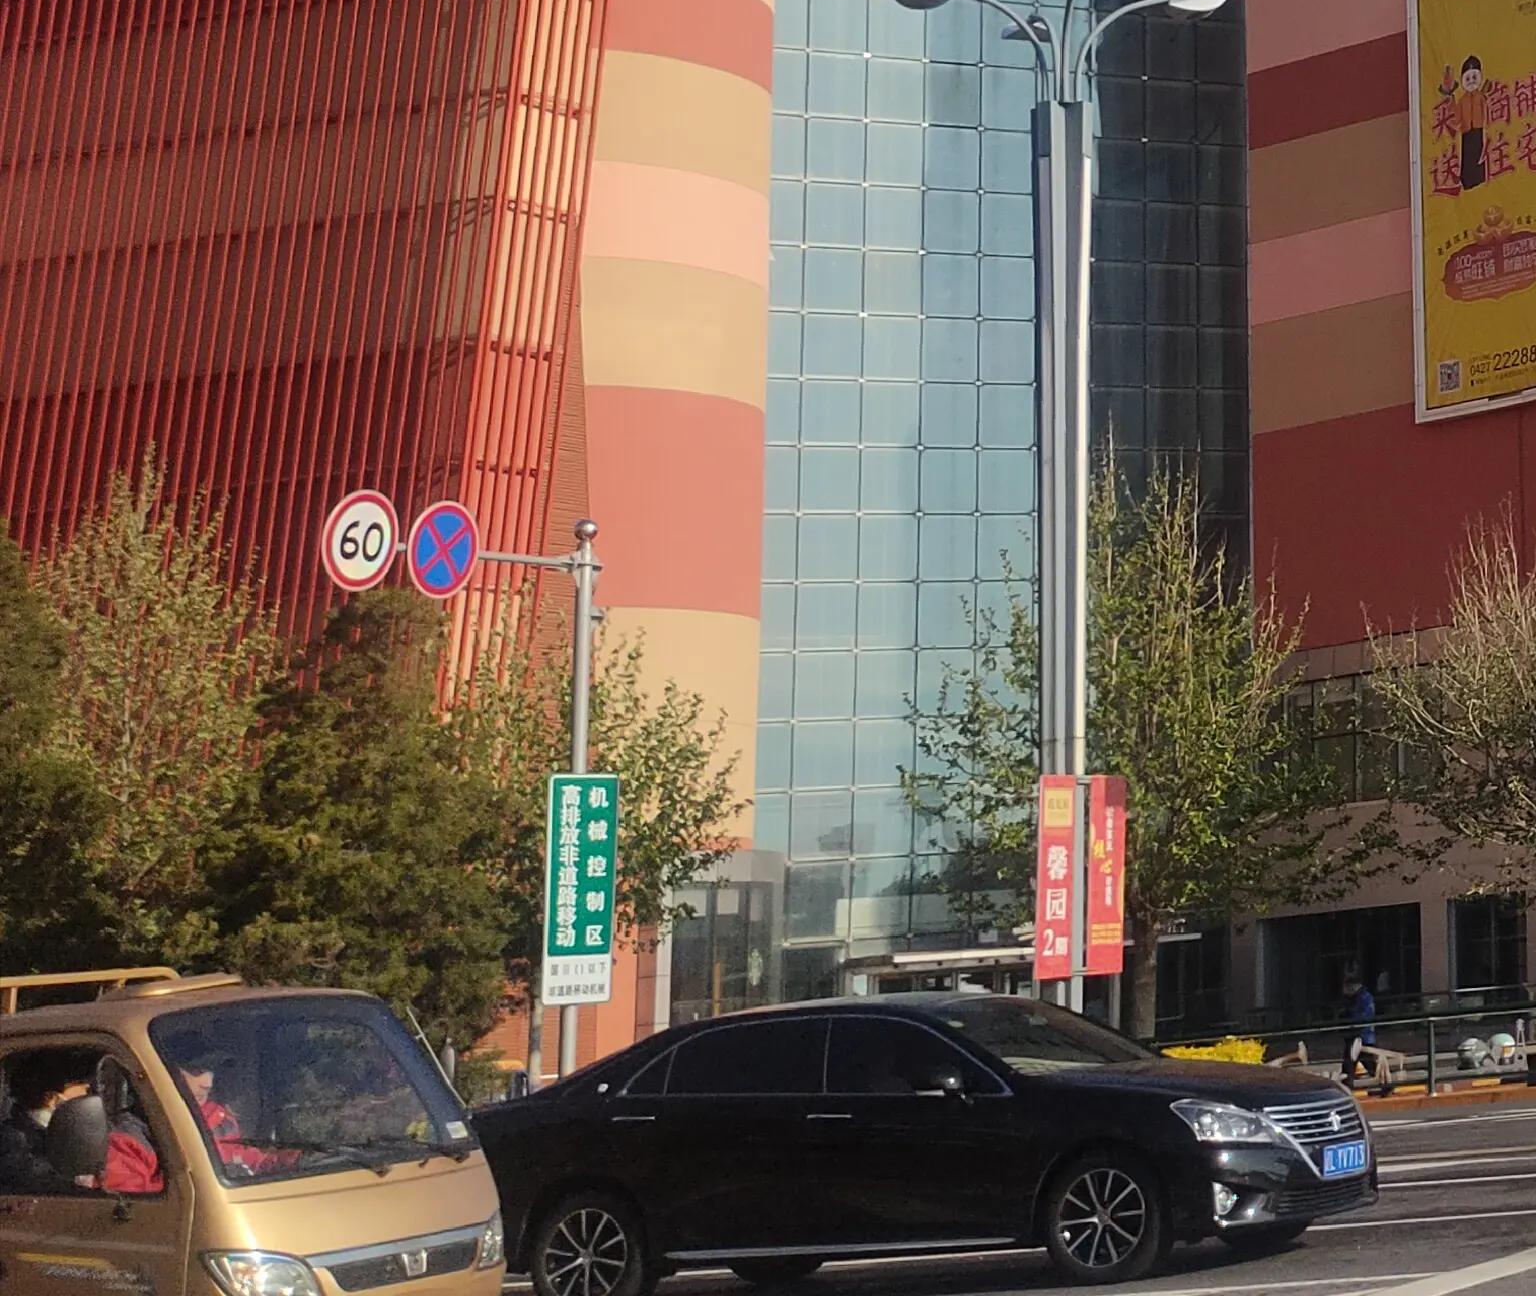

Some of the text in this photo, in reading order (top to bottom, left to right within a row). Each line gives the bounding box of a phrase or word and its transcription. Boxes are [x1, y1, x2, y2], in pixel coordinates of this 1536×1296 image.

[1469, 361, 1491, 377] 0427
[340, 520, 384, 562] 60
[555, 784, 582, 947] 高排放非道路移动
[585, 786, 609, 946] 机械控制区
